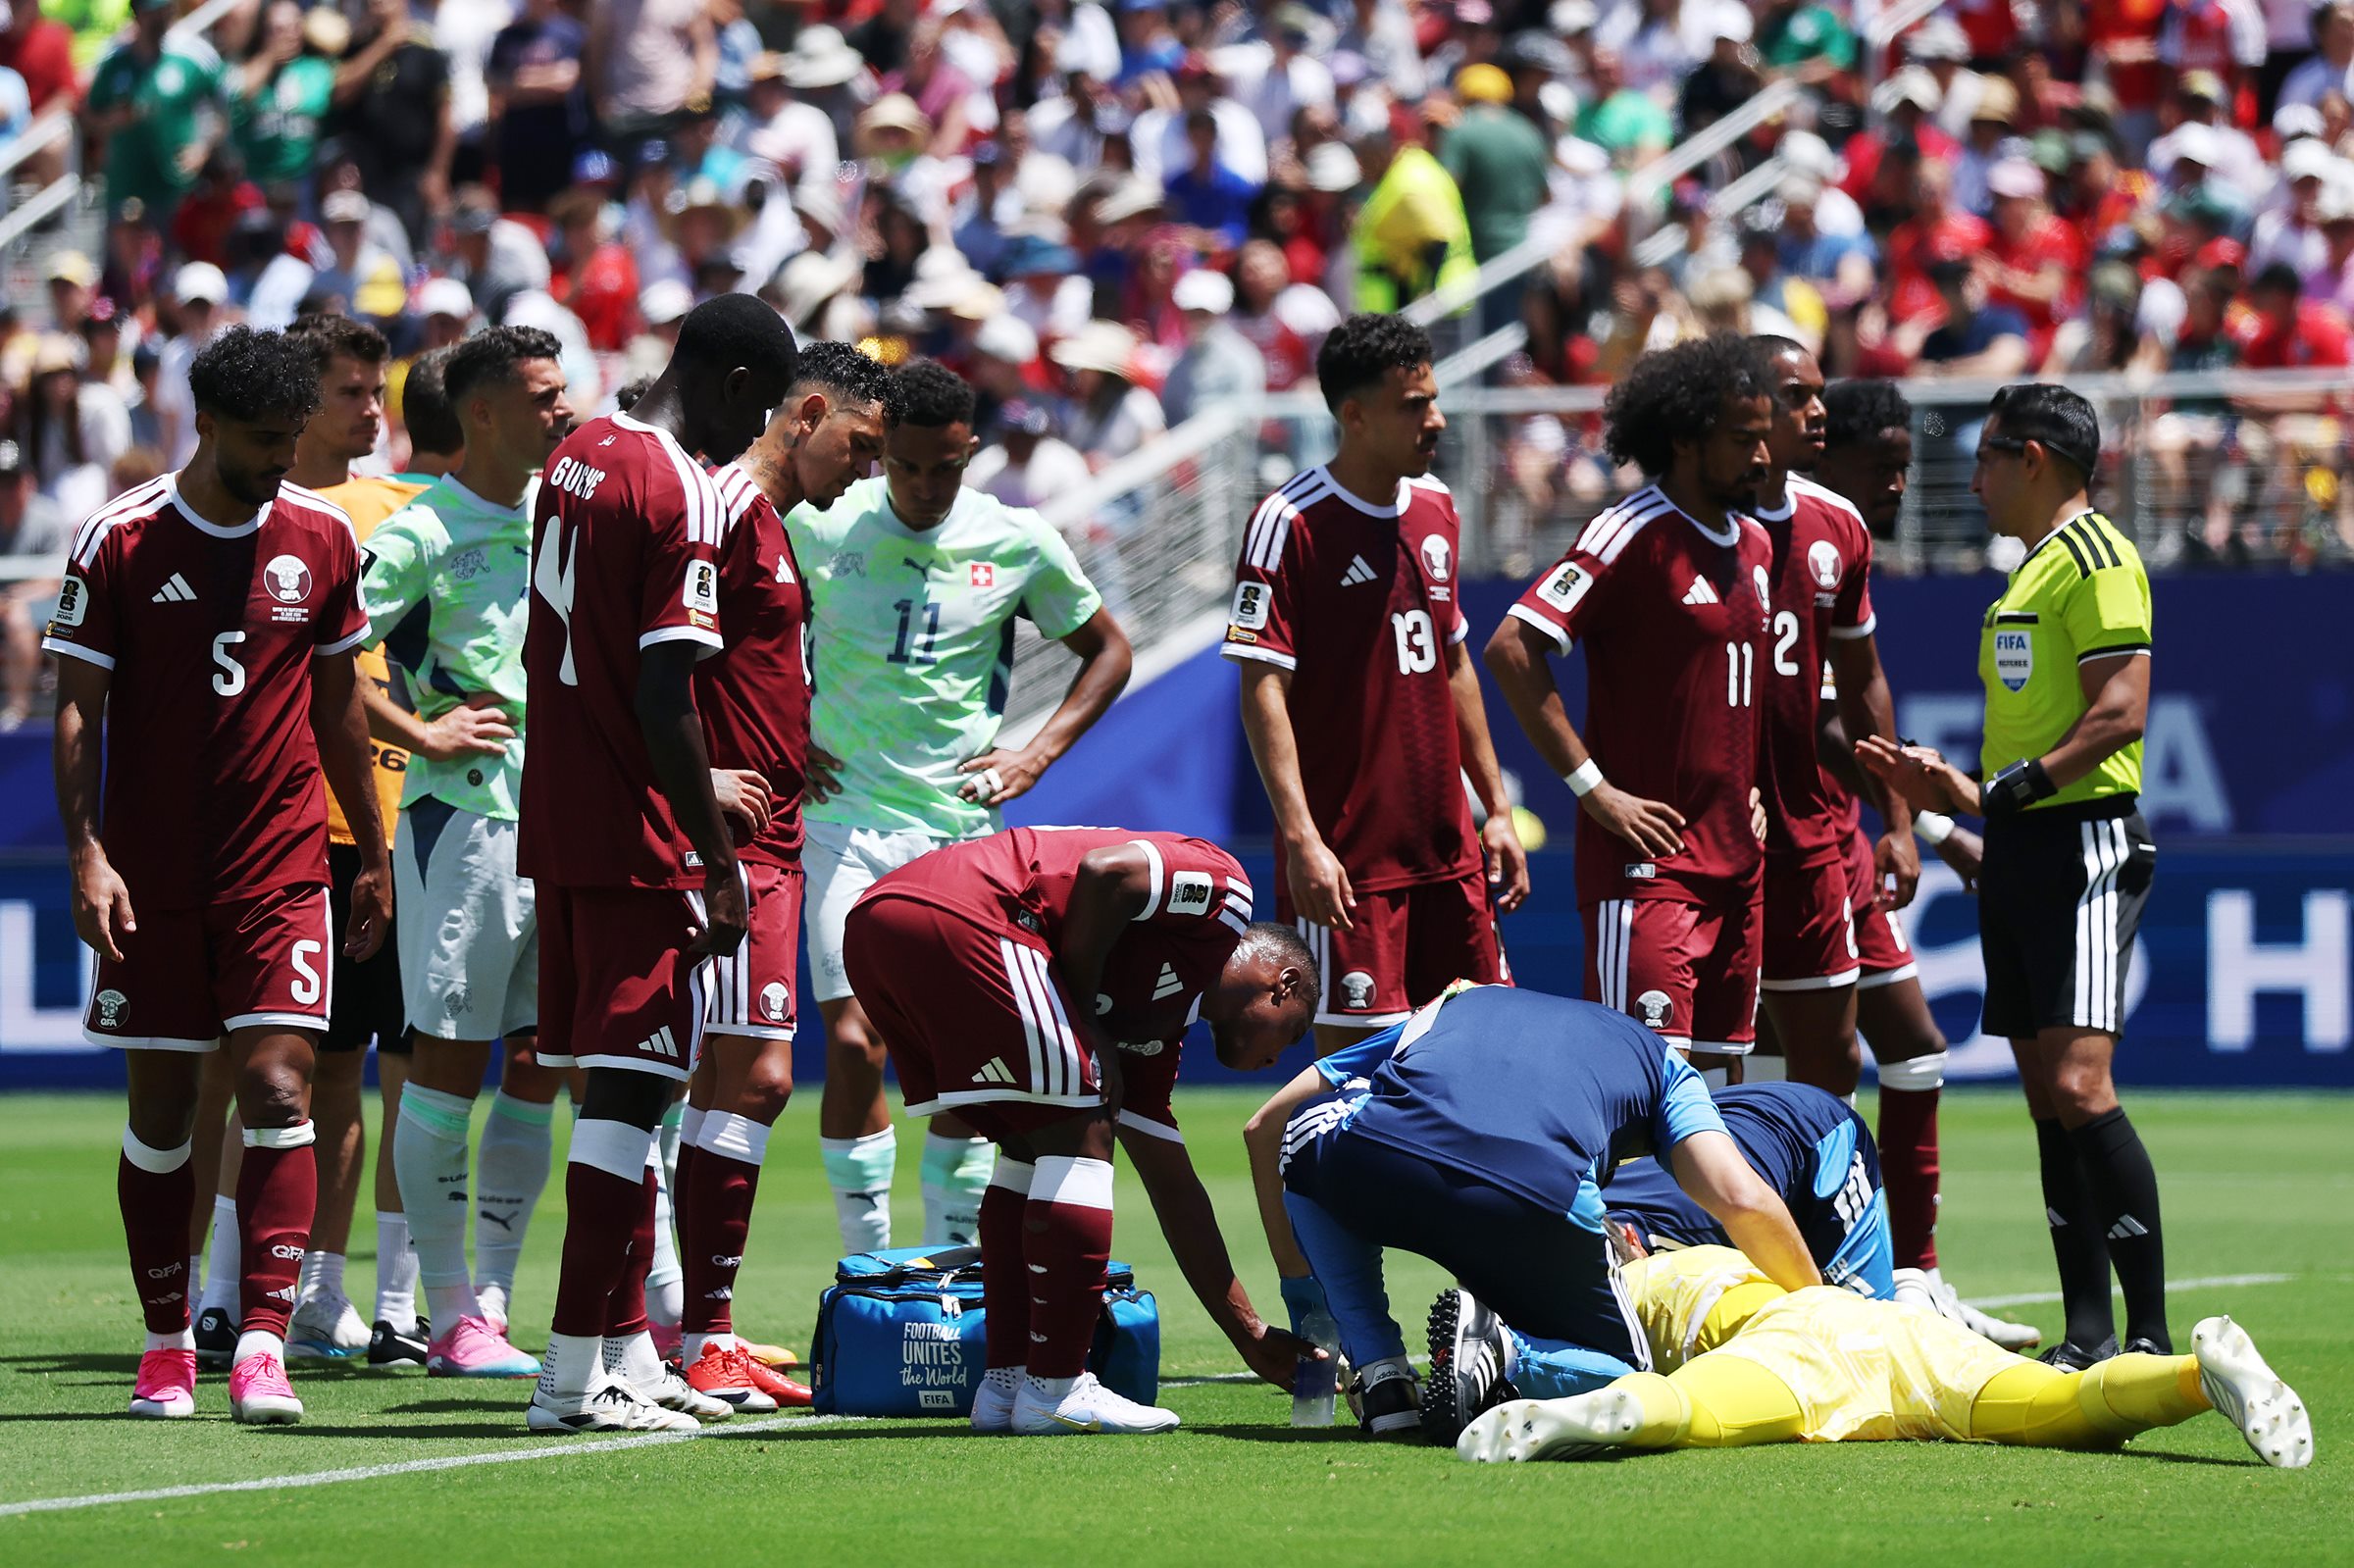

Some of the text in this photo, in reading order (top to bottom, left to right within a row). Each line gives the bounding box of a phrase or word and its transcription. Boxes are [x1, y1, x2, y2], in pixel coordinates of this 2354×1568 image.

[887, 598, 942, 665] 11
[1391, 609, 1436, 675] 13
[1773, 610, 1799, 677] 2
[1997, 635, 2026, 650] FIFA
[212, 631, 246, 696] 5
[1726, 641, 1753, 707] 11
[290, 939, 322, 1004] 5
[100, 1016, 118, 1027] QFA
[148, 1261, 182, 1279] QFA
[903, 1322, 961, 1341] FOOTBALL
[902, 1340, 962, 1365] UNITES
[899, 1365, 967, 1388] the World
[924, 1394, 949, 1404] FIFA
